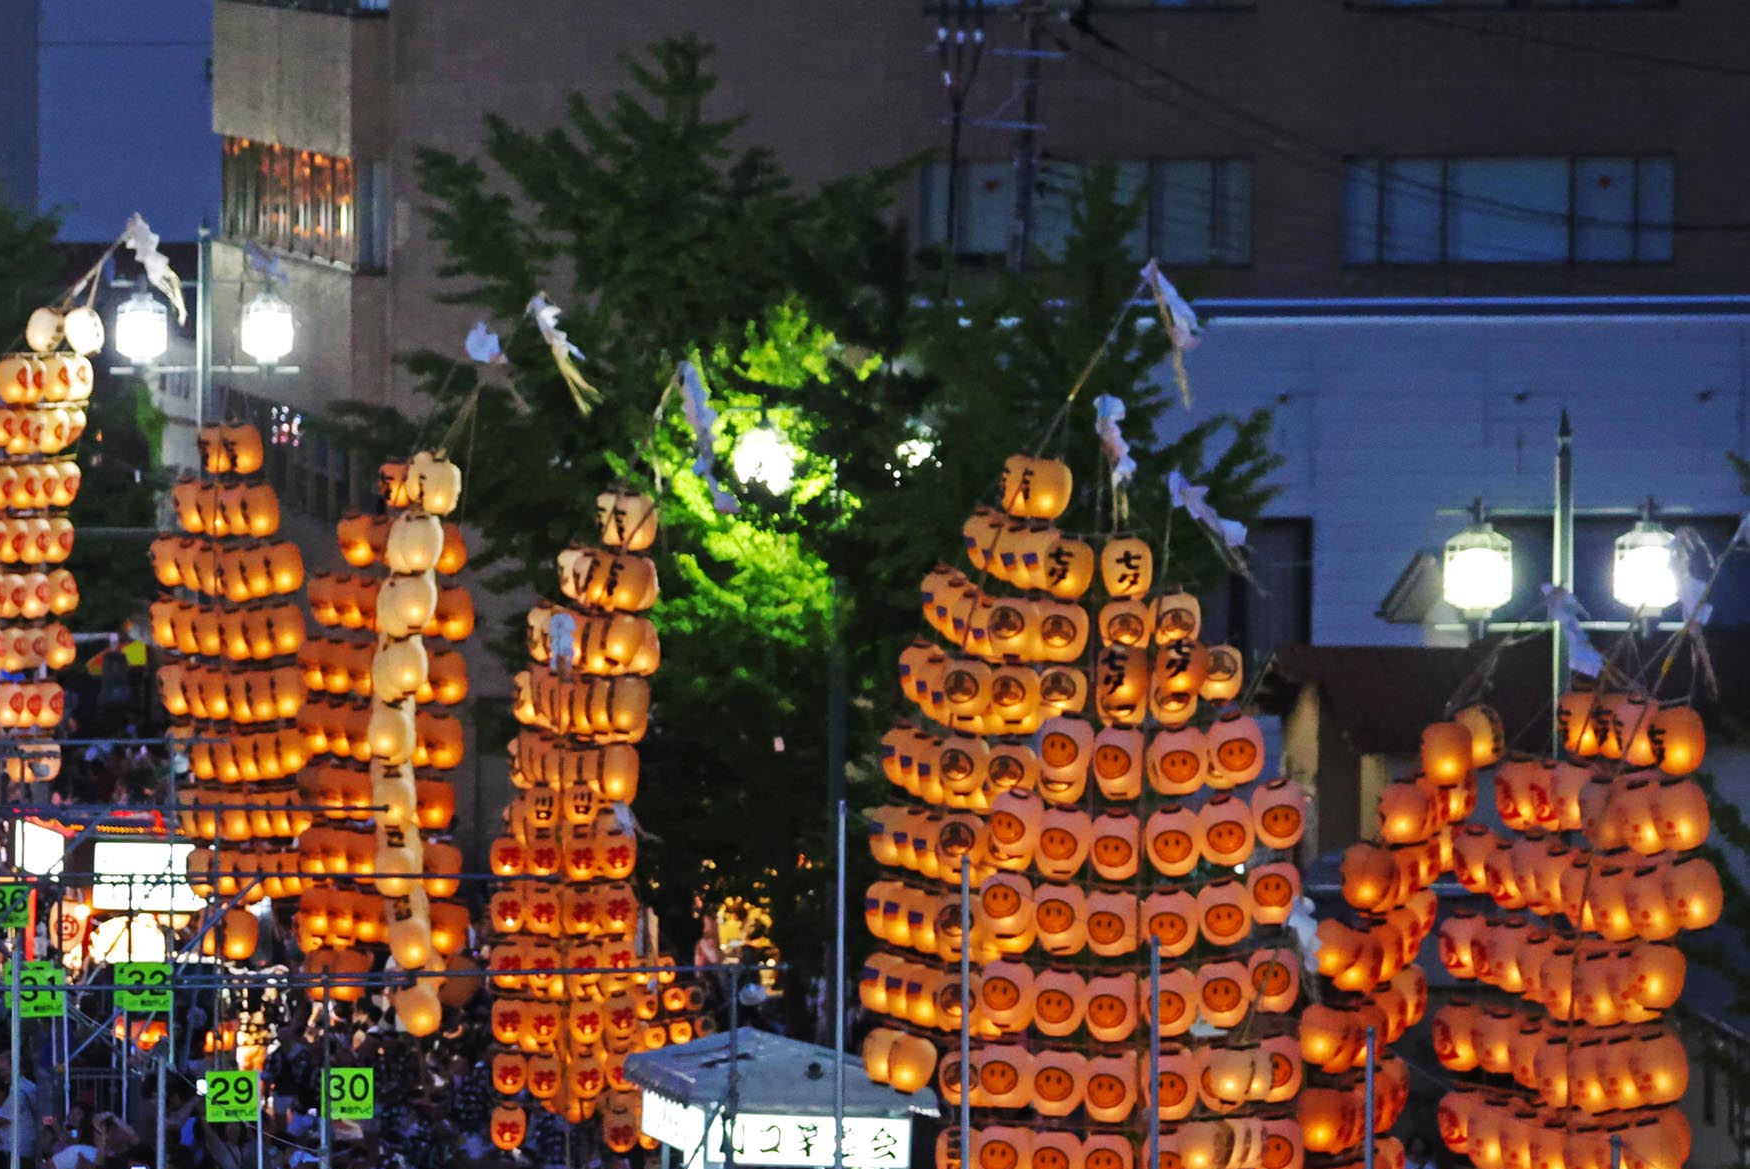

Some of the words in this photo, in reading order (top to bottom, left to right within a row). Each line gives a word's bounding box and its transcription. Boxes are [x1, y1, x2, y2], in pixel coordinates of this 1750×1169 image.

[1049, 547, 1074, 585] 七夕
[1116, 551, 1142, 586] 七夕
[19, 975, 57, 1002] 31
[127, 970, 168, 997] 32
[210, 1076, 254, 1105] 29
[328, 1073, 370, 1102] 30
